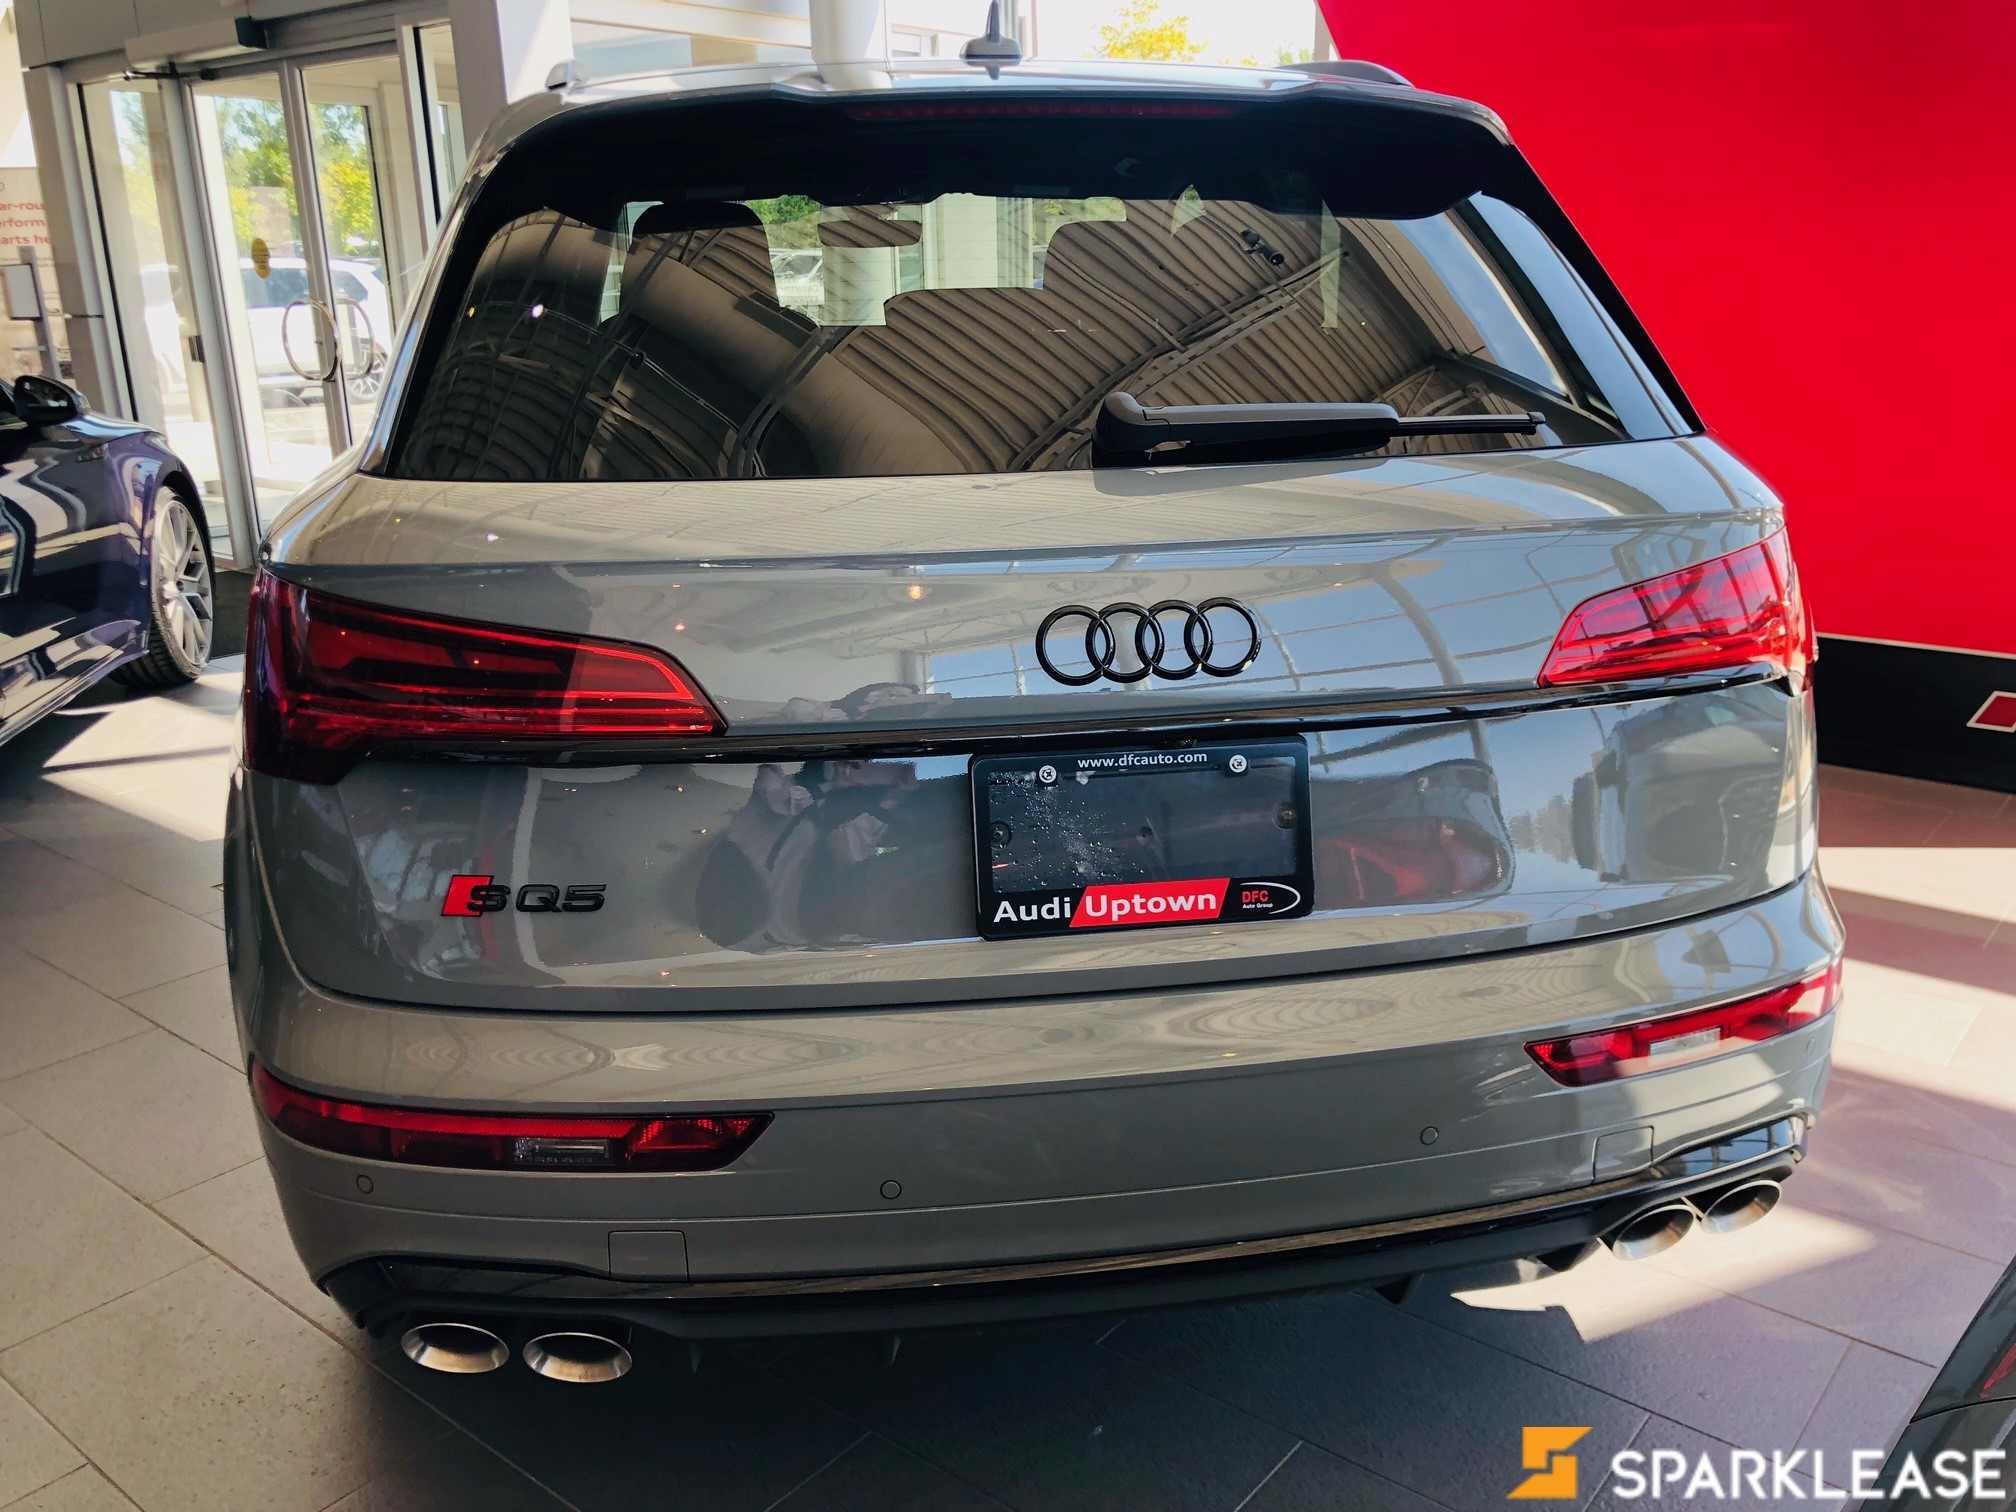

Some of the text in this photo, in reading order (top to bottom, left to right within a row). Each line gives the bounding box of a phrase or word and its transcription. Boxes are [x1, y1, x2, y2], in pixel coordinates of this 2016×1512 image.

[1077, 753, 1207, 768] www.dfcauto.com
[466, 884, 607, 913] SQ5
[993, 892, 1217, 923] Audi Uptown
[1242, 890, 1269, 903] DFC
